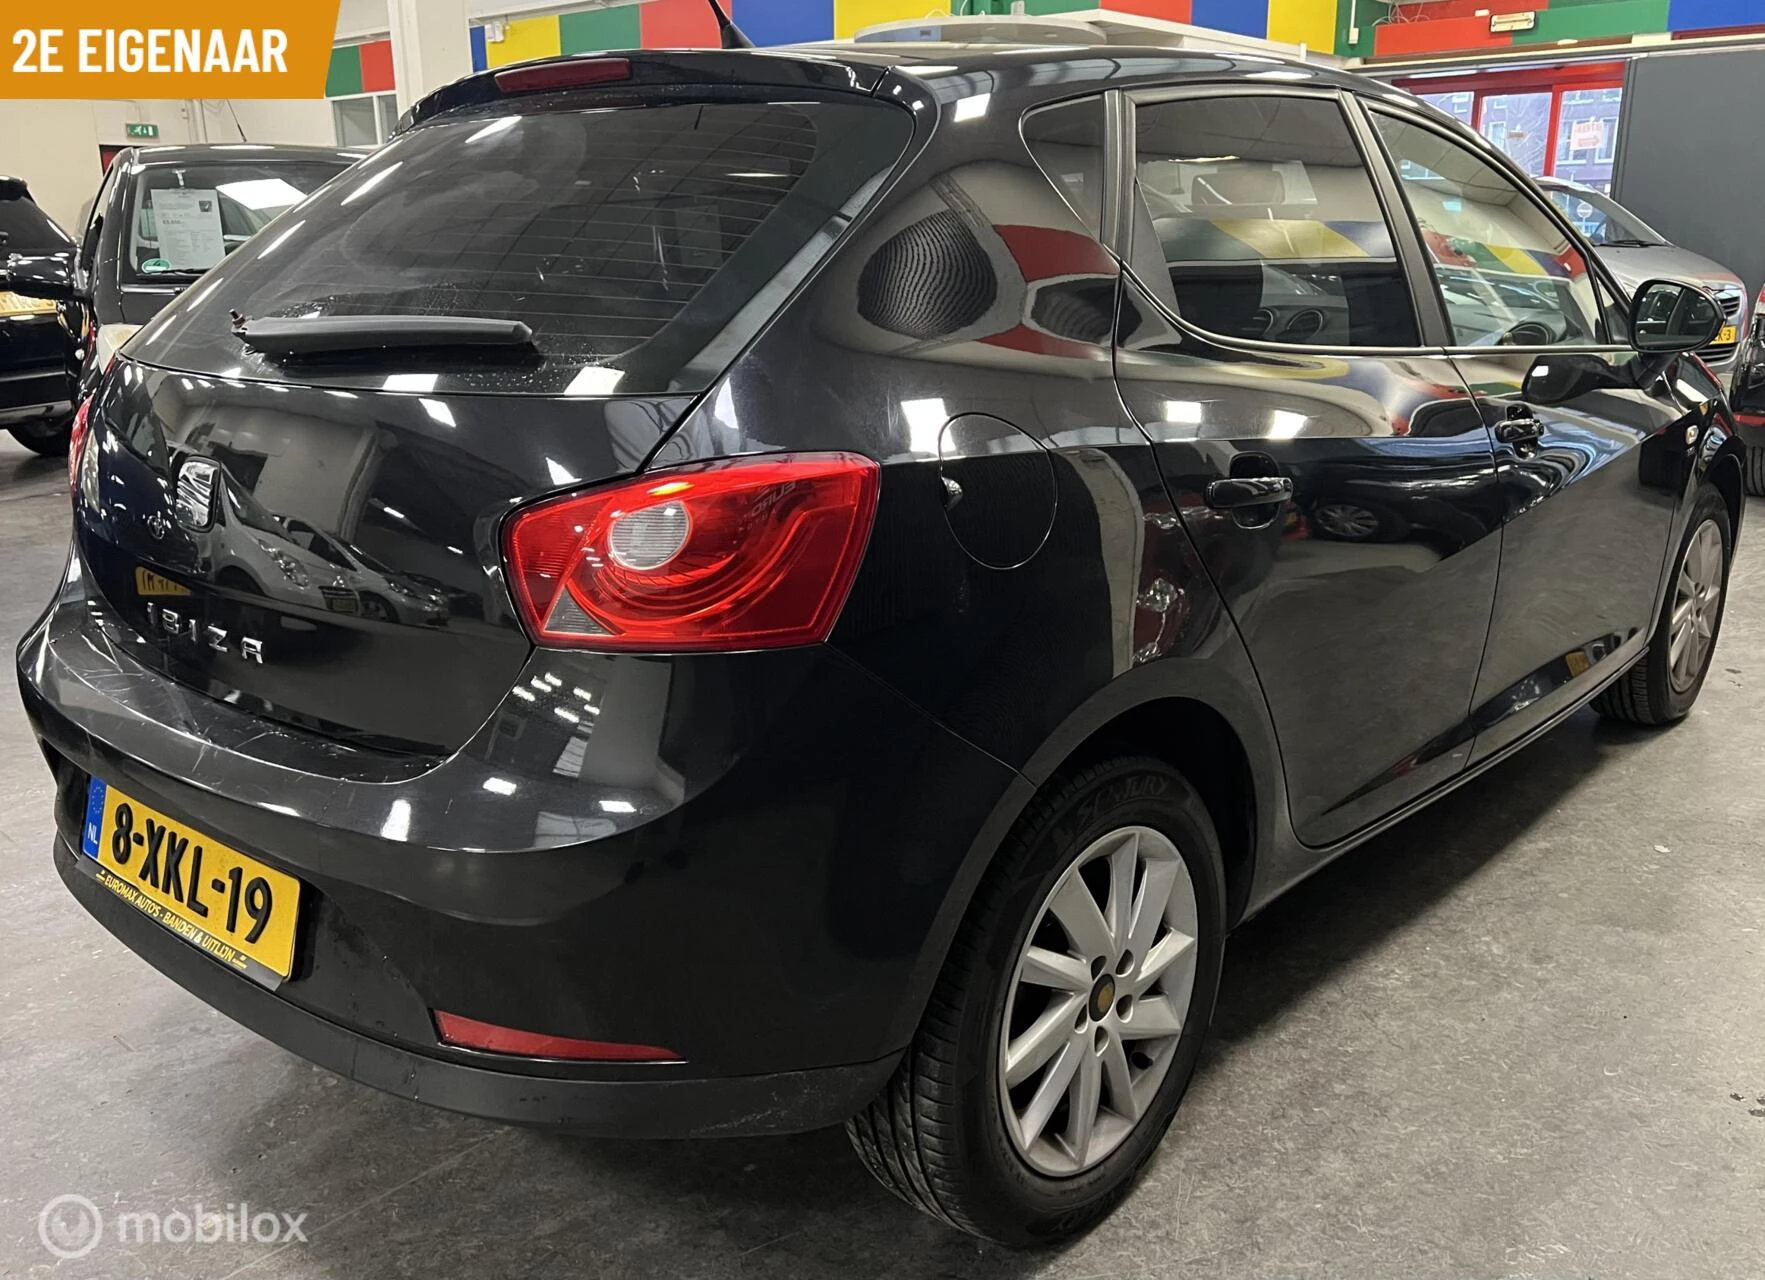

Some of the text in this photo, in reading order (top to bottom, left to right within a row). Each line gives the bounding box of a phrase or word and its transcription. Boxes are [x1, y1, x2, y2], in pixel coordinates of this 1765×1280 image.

[147, 602, 264, 664] IBIZA
[87, 822, 98, 845] NL
[111, 802, 273, 945] 8-XKL-19
[104, 874, 138, 903] EUROMAX
[134, 895, 162, 917] AUTO'S
[162, 911, 198, 940] BANDEN
[193, 931, 203, 944] &
